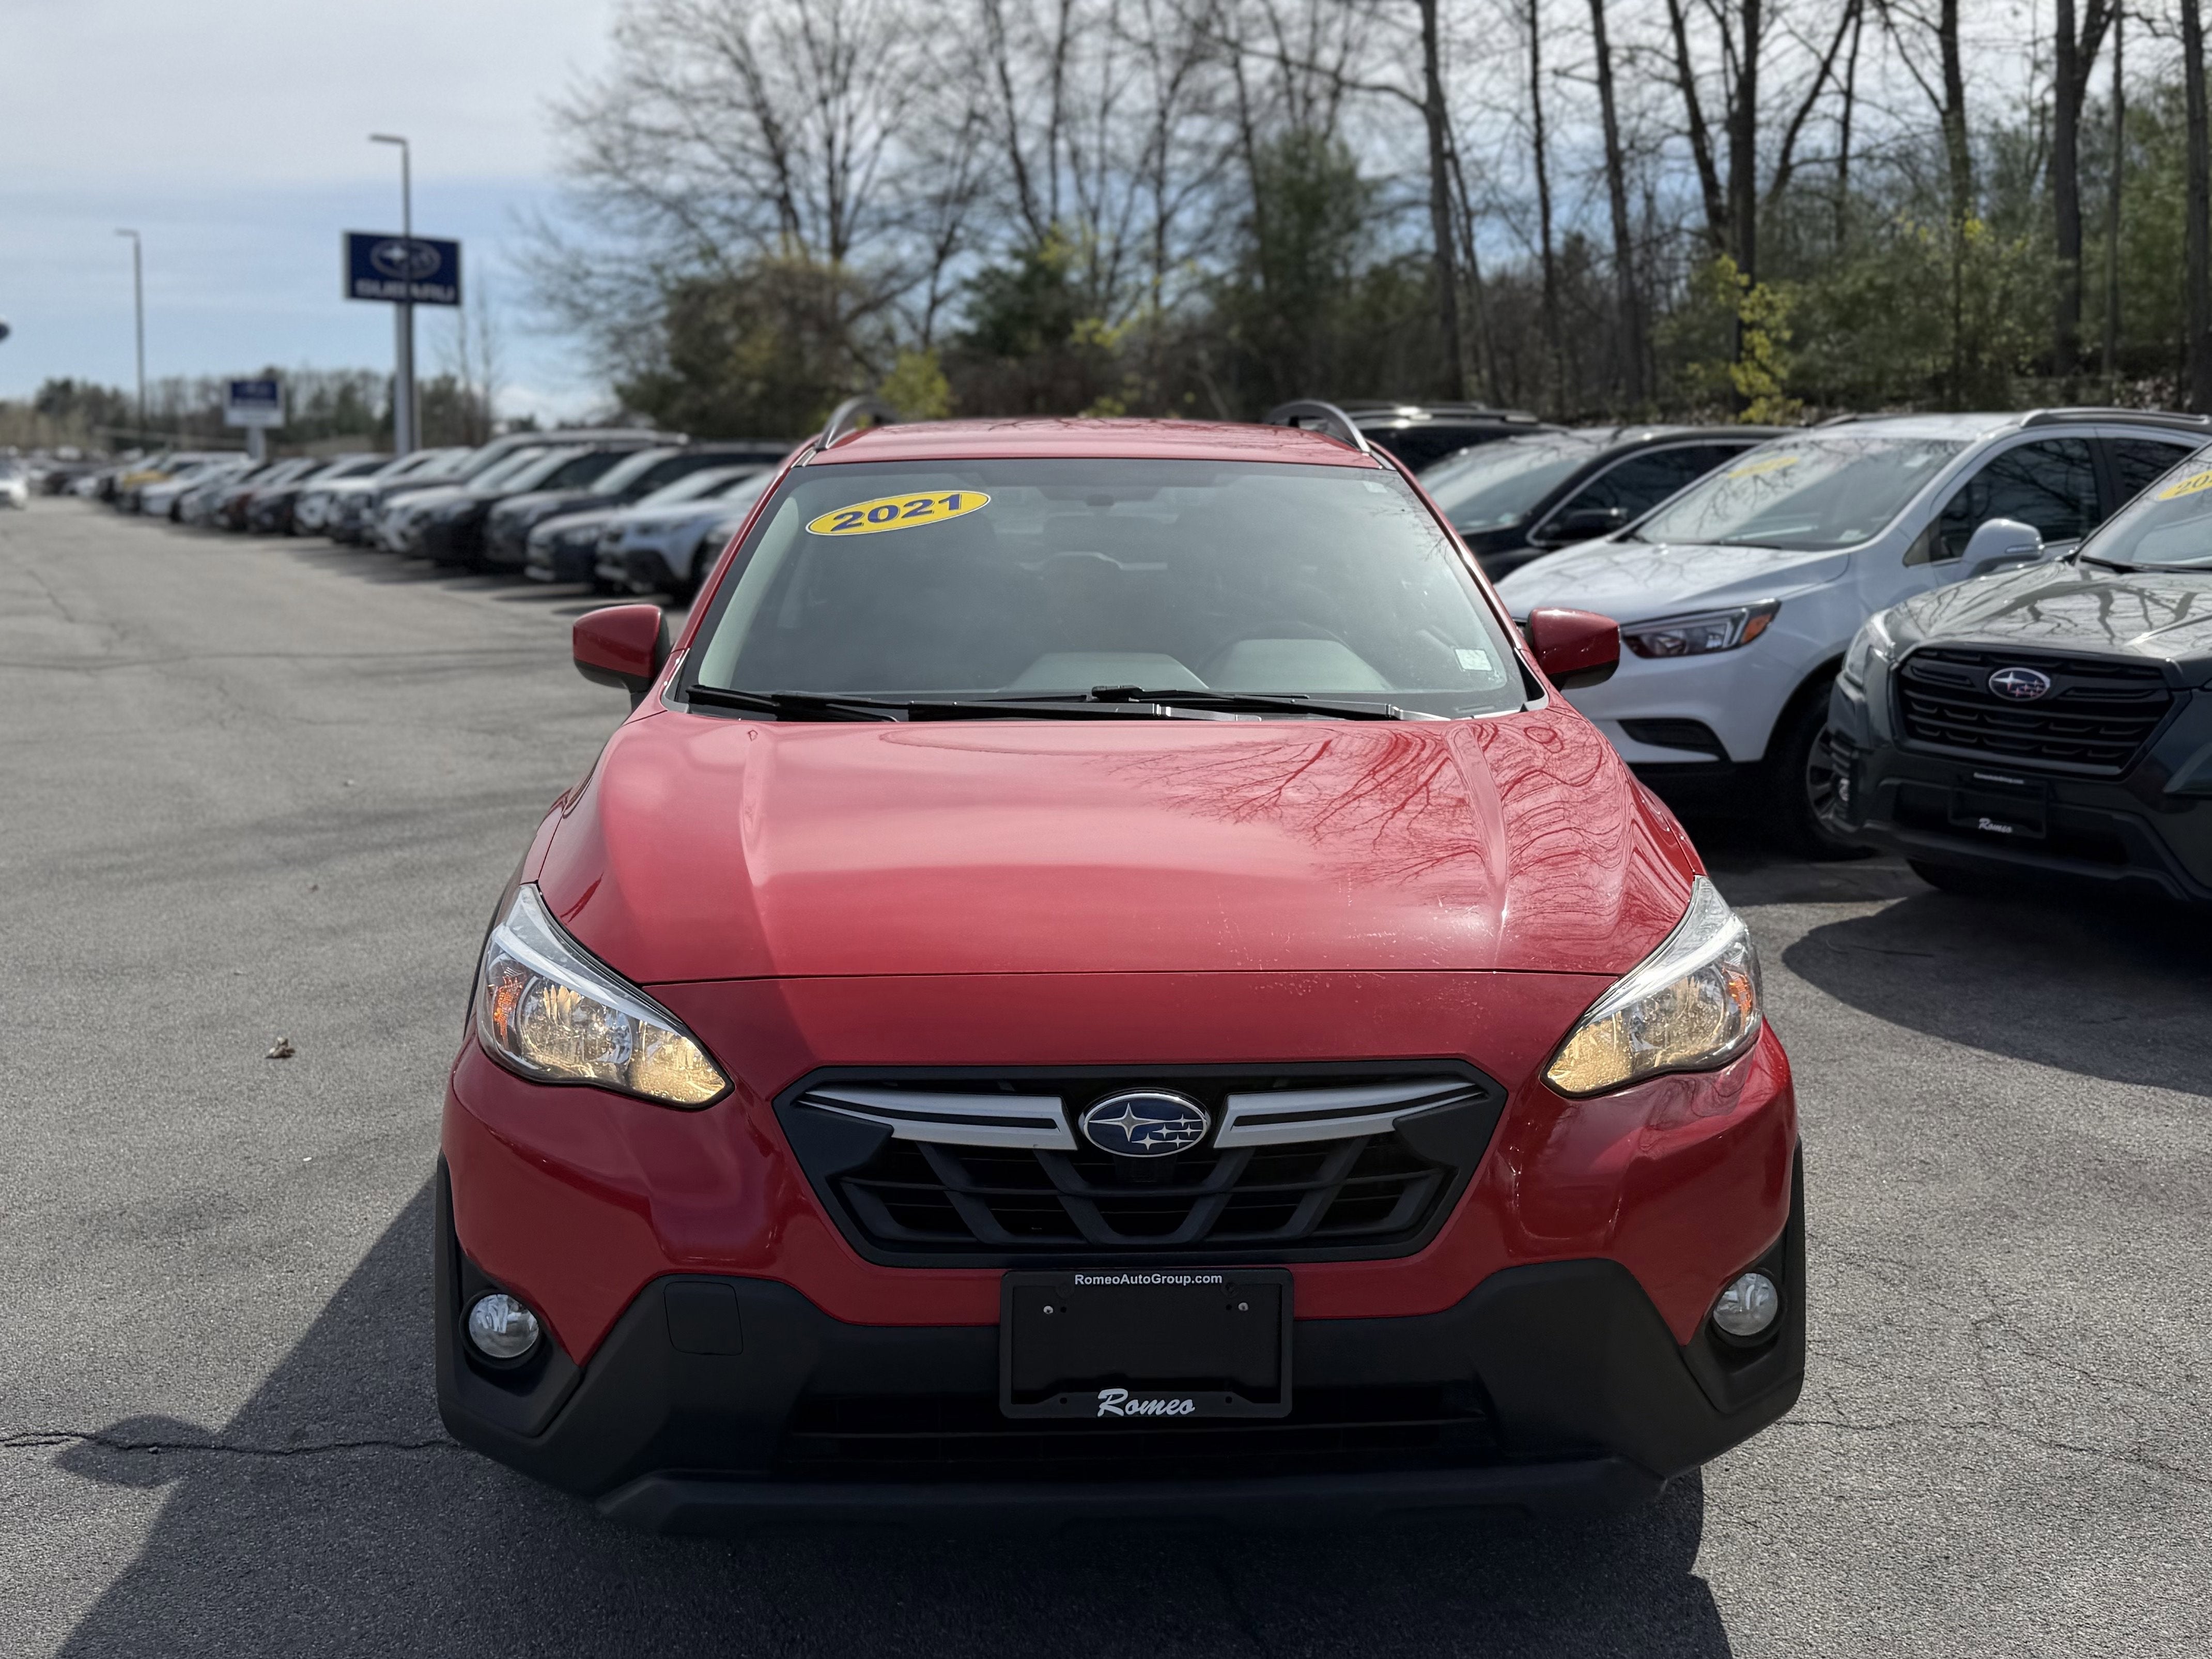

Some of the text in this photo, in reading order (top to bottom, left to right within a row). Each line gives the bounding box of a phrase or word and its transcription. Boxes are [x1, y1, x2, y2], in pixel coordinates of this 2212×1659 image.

[2174, 475, 2212, 495] 20
[830, 493, 962, 532] 2021
[1978, 817, 2013, 833] Romeo
[1075, 1274, 1223, 1285] RomeoAutoGroup.com
[1097, 1388, 1196, 1417] Romeo
